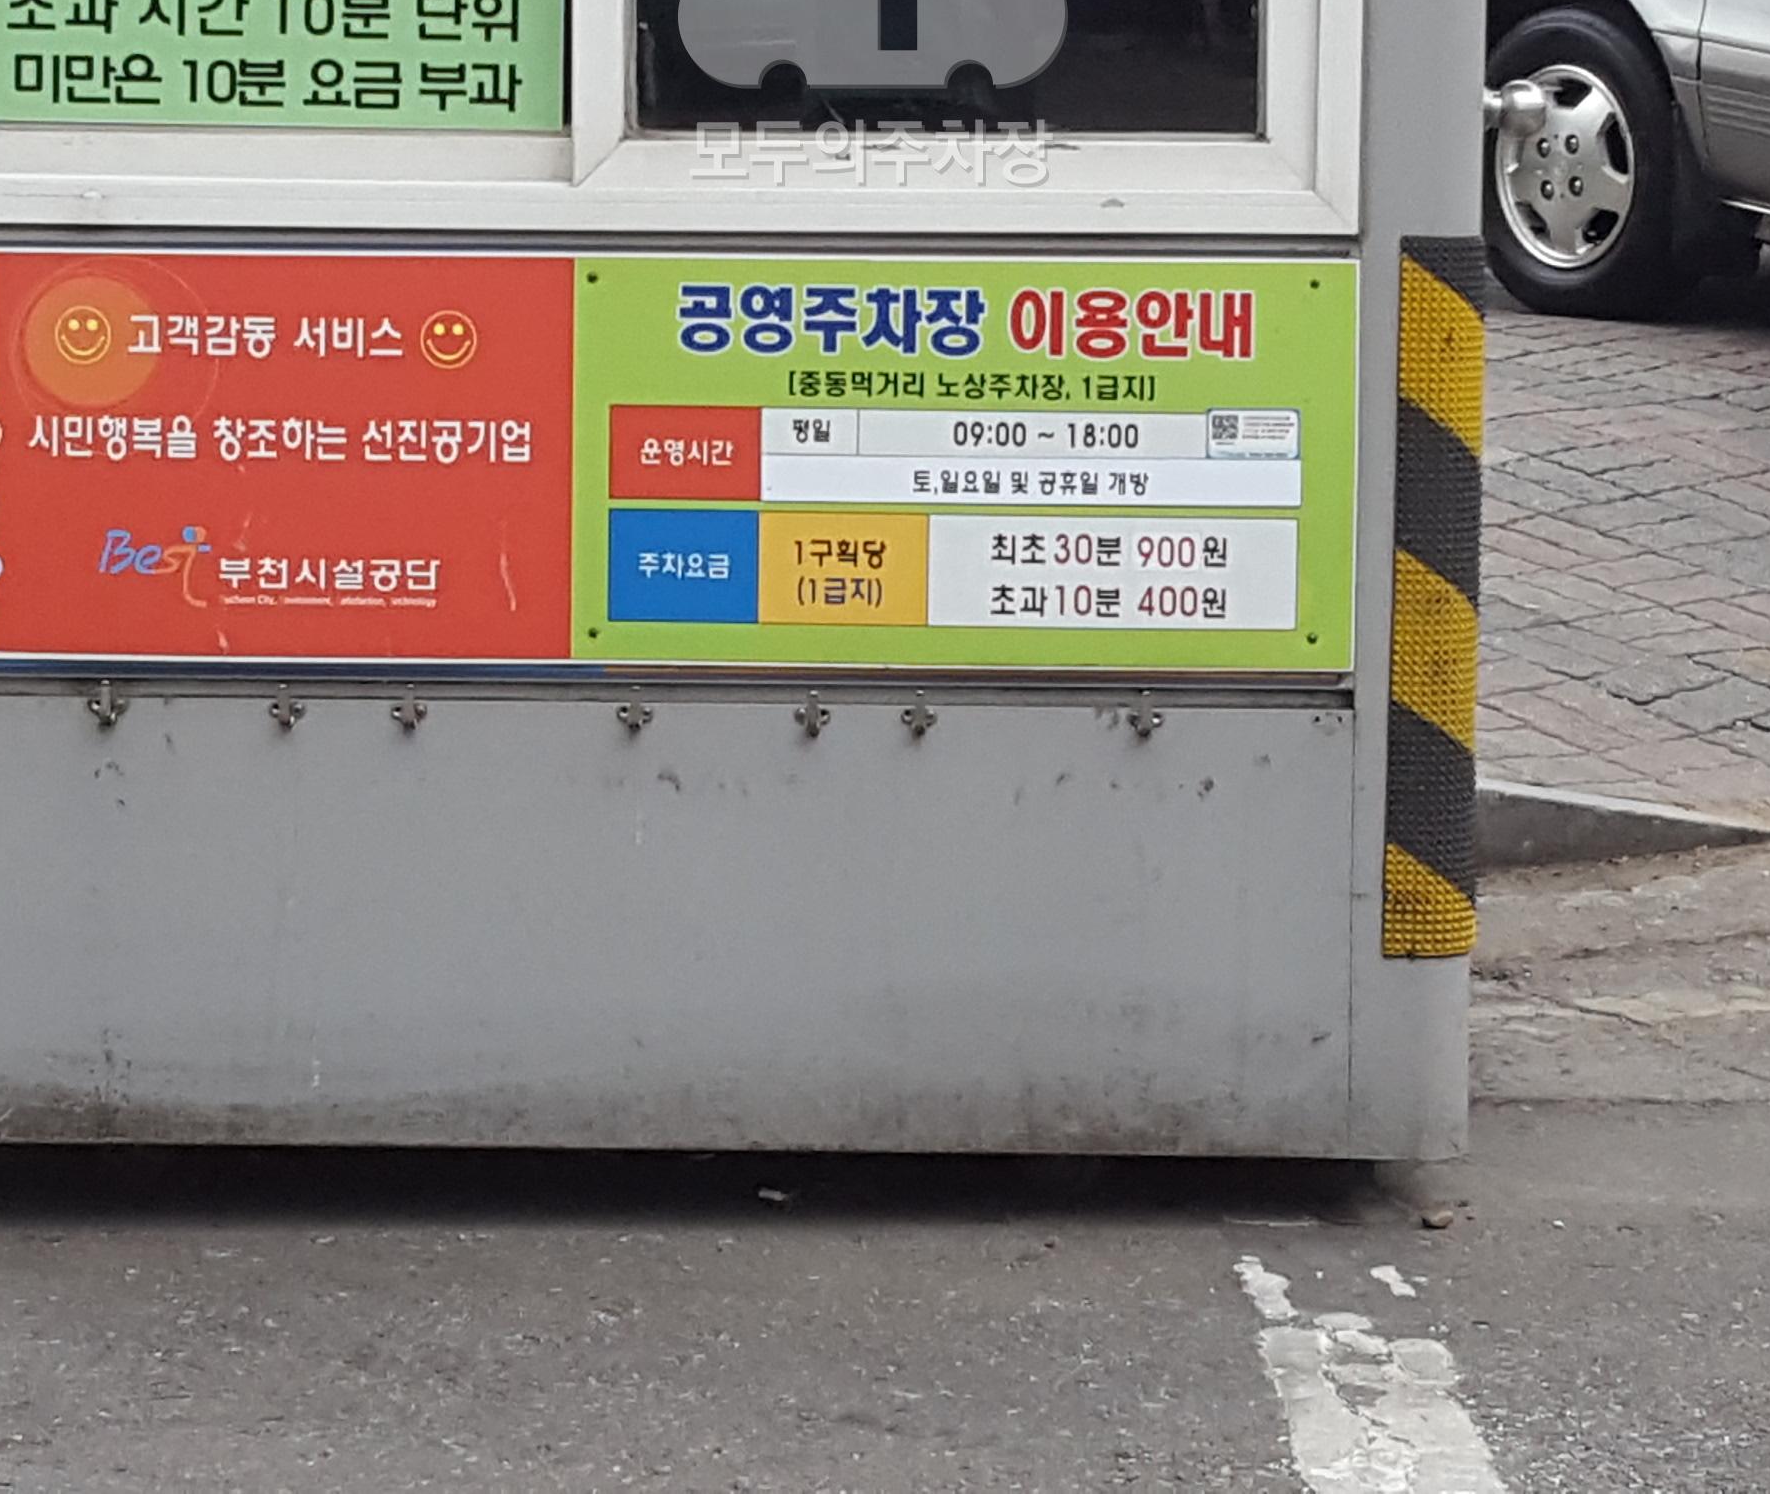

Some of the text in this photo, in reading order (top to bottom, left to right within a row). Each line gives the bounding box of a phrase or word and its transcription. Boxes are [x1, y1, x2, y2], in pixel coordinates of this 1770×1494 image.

[15, 53, 522, 113] 미만은 10분 요금 부과
[128, 315, 403, 359] 고객감동 서비스
[678, 283, 1255, 361] 공영주차장 이용안내
[30, 414, 532, 464] 시민행복을 창조하는 선진공기업
[792, 418, 831, 444] 평일
[953, 422, 1027, 449] 09:00
[1067, 423, 1140, 450] 18:00
[638, 437, 735, 467] 운영시간
[1011, 470, 1028, 496] 및
[1038, 471, 1099, 496] 공휴일
[1107, 471, 1149, 497] 개방
[98, 528, 212, 608] Best
[638, 552, 731, 581] 주차요금
[793, 538, 887, 569] 1구획당
[219, 556, 440, 593] 부천시설공단
[797, 576, 882, 607] (1급지)
